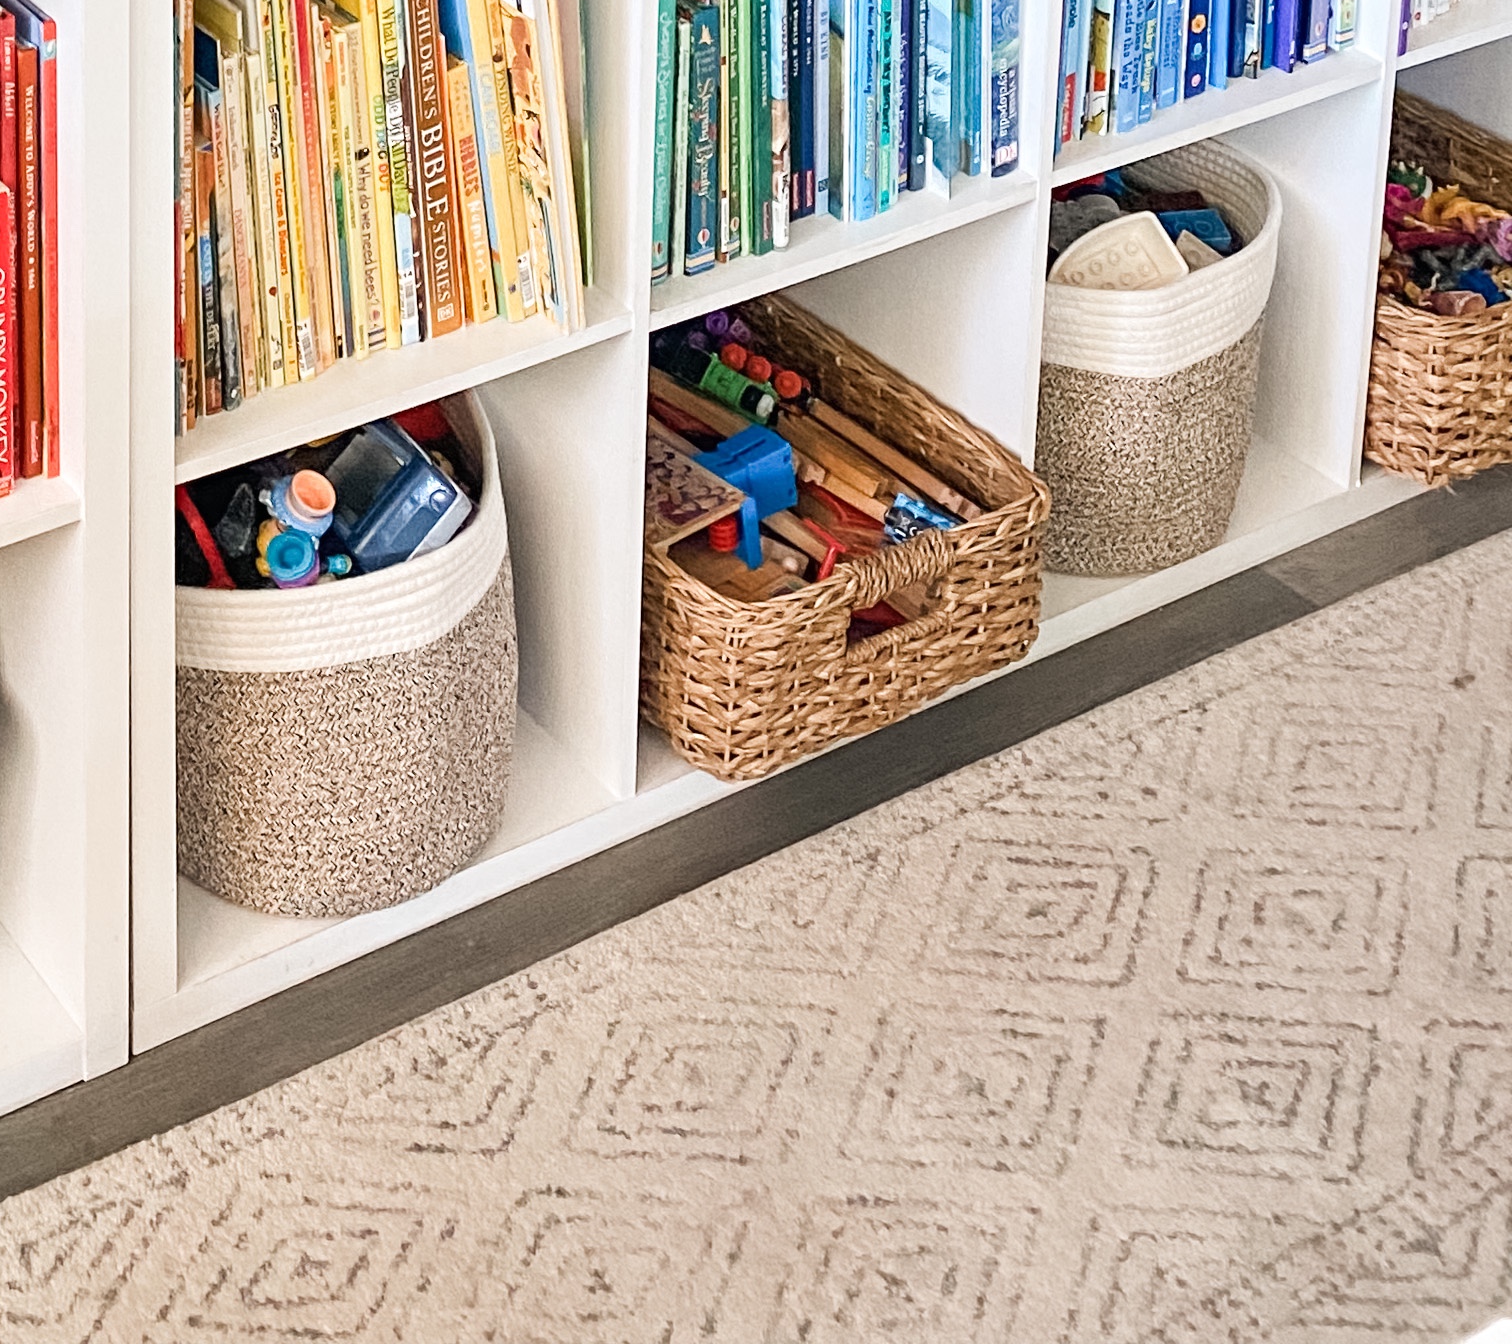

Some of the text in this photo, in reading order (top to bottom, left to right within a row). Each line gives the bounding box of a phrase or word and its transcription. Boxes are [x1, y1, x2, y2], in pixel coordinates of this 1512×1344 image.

[421, 122, 450, 222] BIBLE
[357, 163, 379, 307] Why do we need bees?
[431, 221, 451, 303] STORIES
